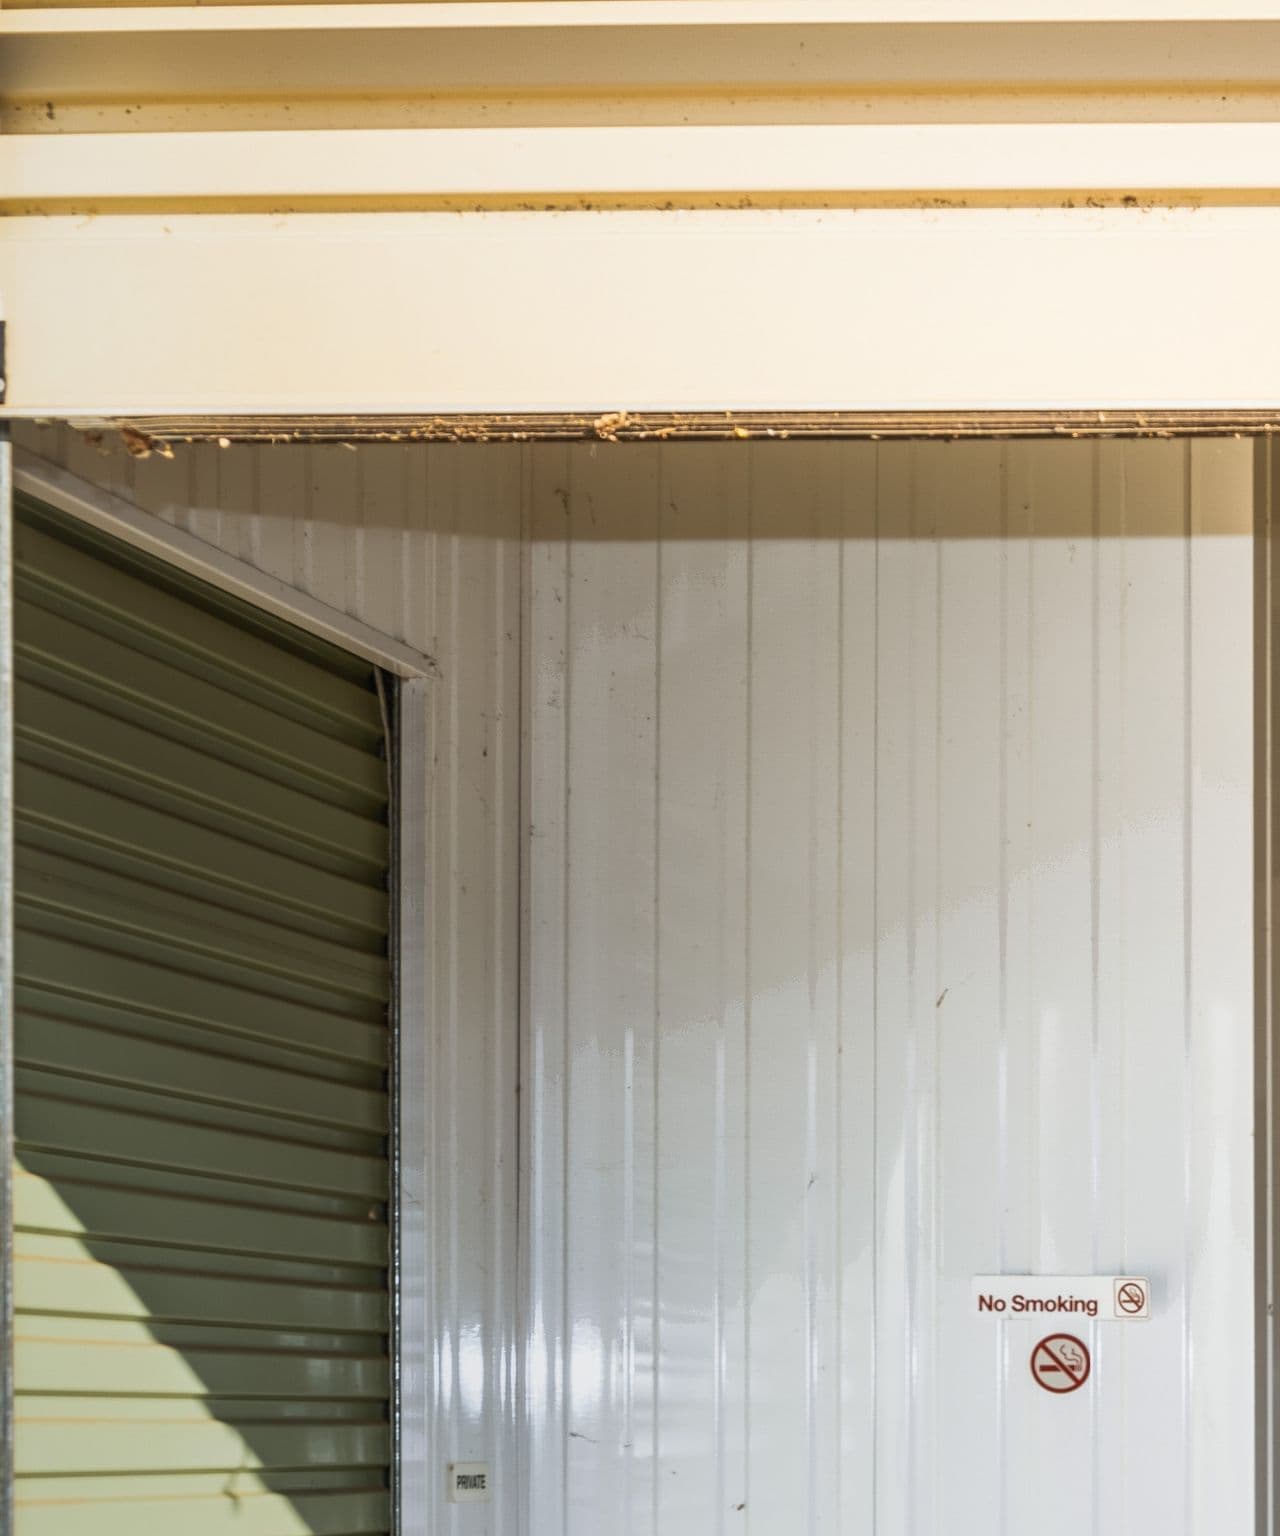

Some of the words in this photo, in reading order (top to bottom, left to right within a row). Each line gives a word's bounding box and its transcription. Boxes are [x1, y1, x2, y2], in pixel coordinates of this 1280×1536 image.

[978, 1295, 1006, 1312] No
[1011, 1295, 1098, 1317] Smoking
[457, 1474, 486, 1489] PRIVATE
